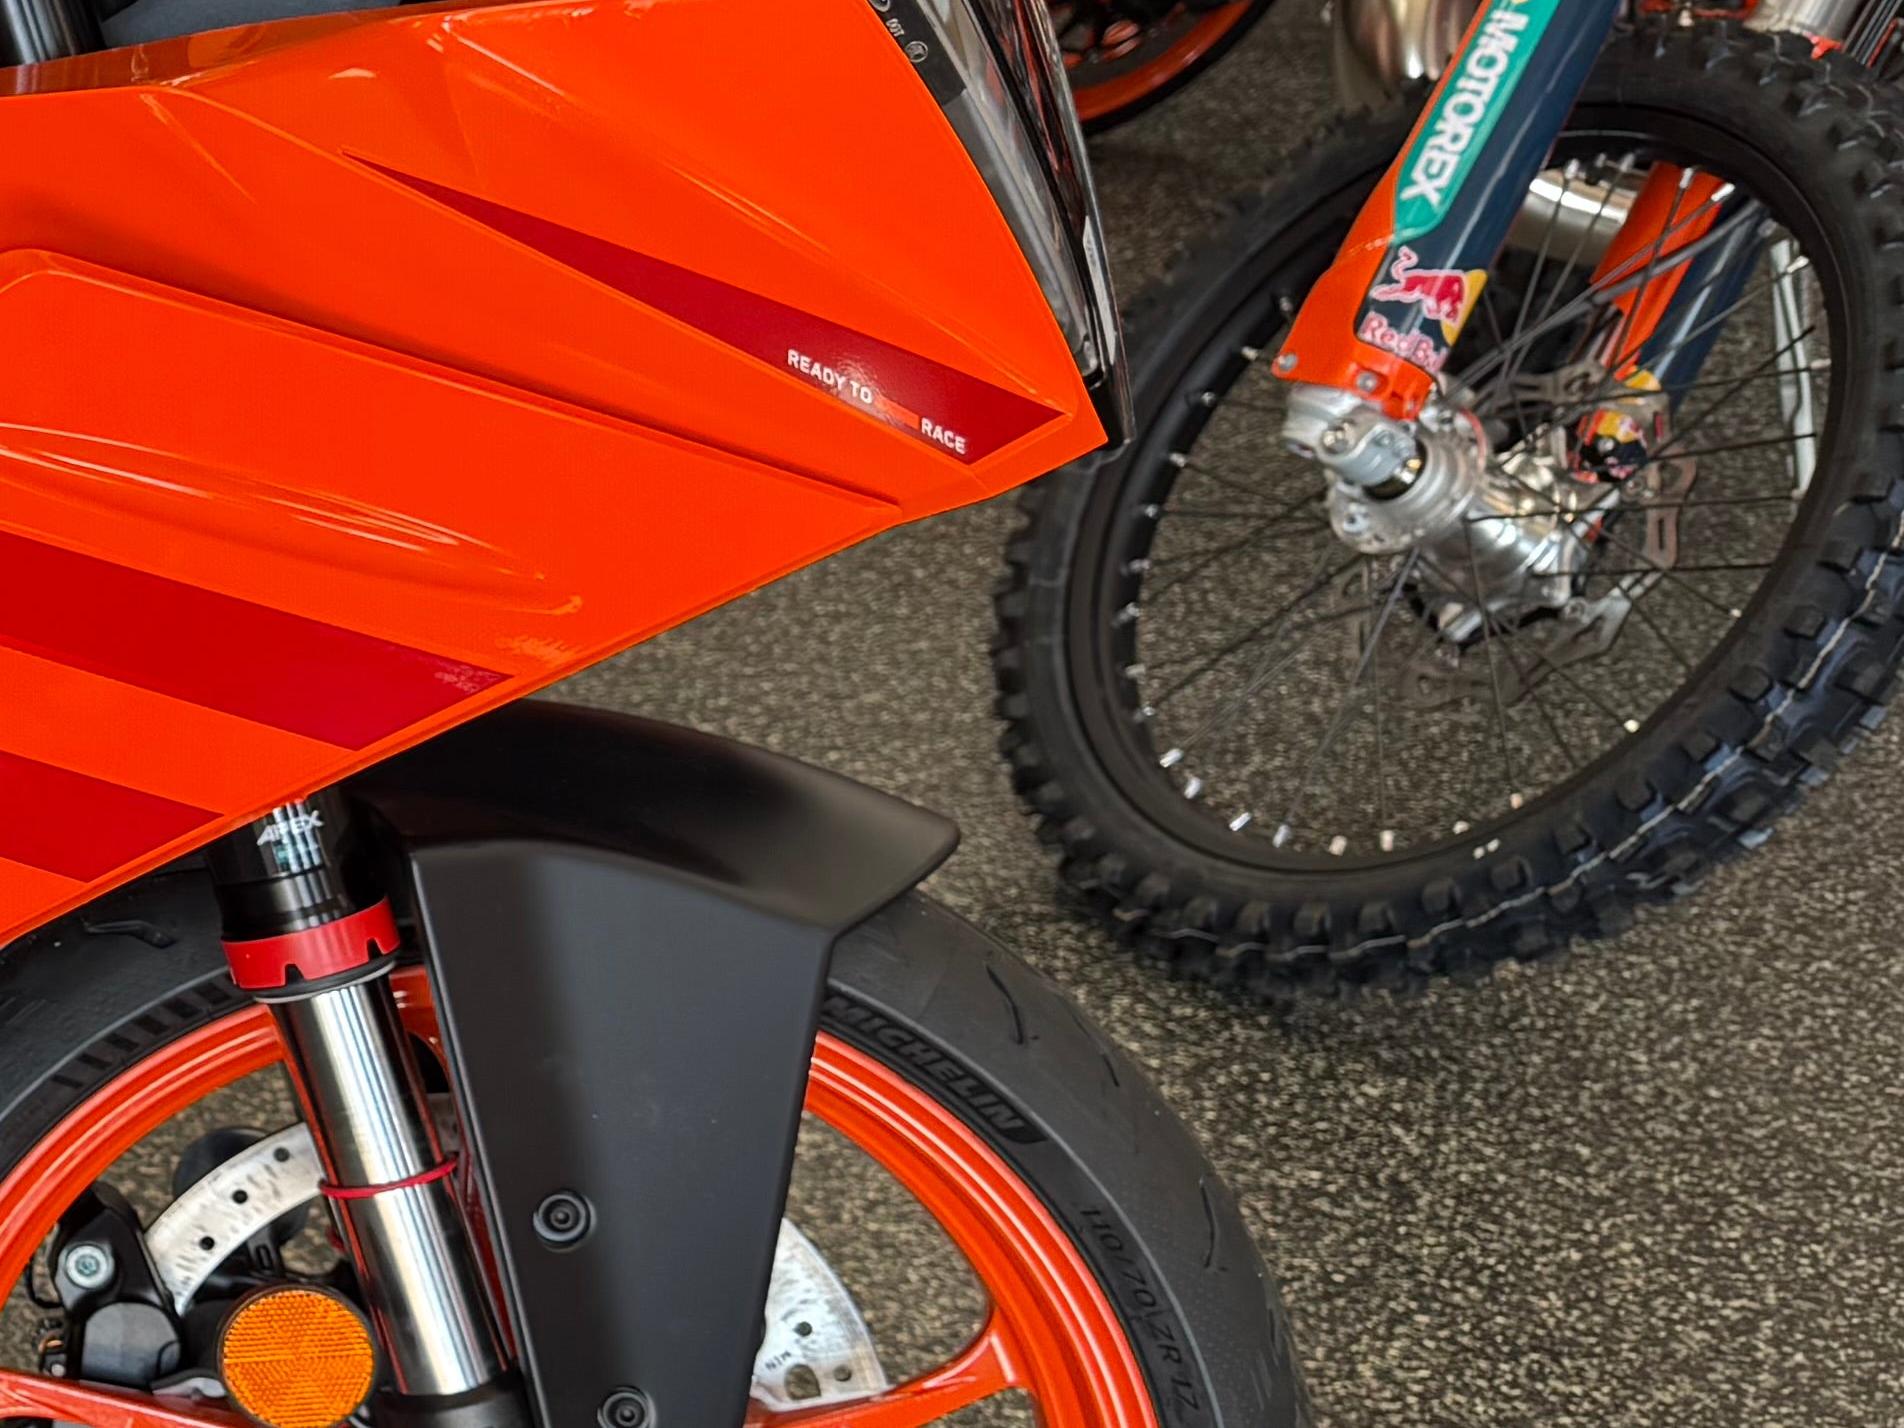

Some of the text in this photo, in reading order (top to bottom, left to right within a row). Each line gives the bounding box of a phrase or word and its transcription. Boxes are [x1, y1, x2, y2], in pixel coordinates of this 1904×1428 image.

[1401, 7, 1525, 207] MOTOREX
[1359, 310, 1416, 357] Red
[787, 348, 967, 455] READY TO RACE
[257, 808, 325, 847] APEX
[828, 998, 1022, 1136] MICHELIN
[1080, 1204, 1159, 1309] 110/70
